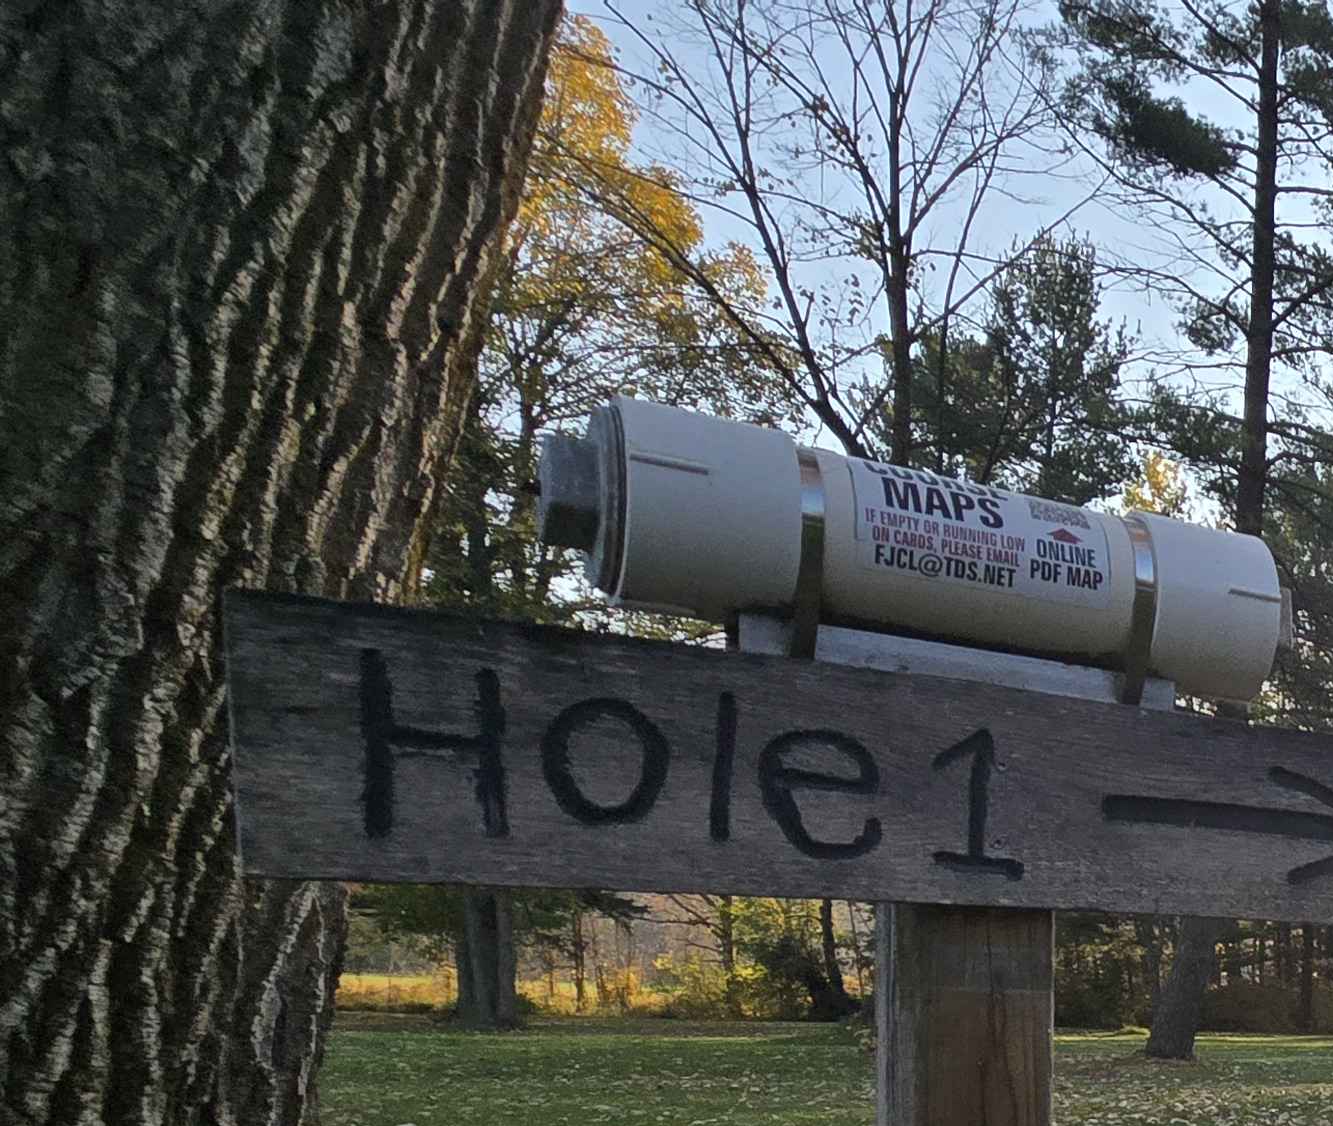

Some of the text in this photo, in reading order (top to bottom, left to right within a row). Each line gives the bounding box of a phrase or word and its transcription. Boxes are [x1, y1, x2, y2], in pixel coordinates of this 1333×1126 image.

[882, 477, 1004, 529] MAPS
[865, 508, 1025, 552] IF EMPTY OR RUNNING LOW
[872, 525, 1020, 567] ON CARDS, PLEASE EMAIL
[874, 544, 1016, 588] FJCL@TDS.NET
[1030, 559, 1103, 590] PDF MAP
[1036, 538, 1096, 568] ONLINE
[360, 647, 1025, 881] Hole 1
